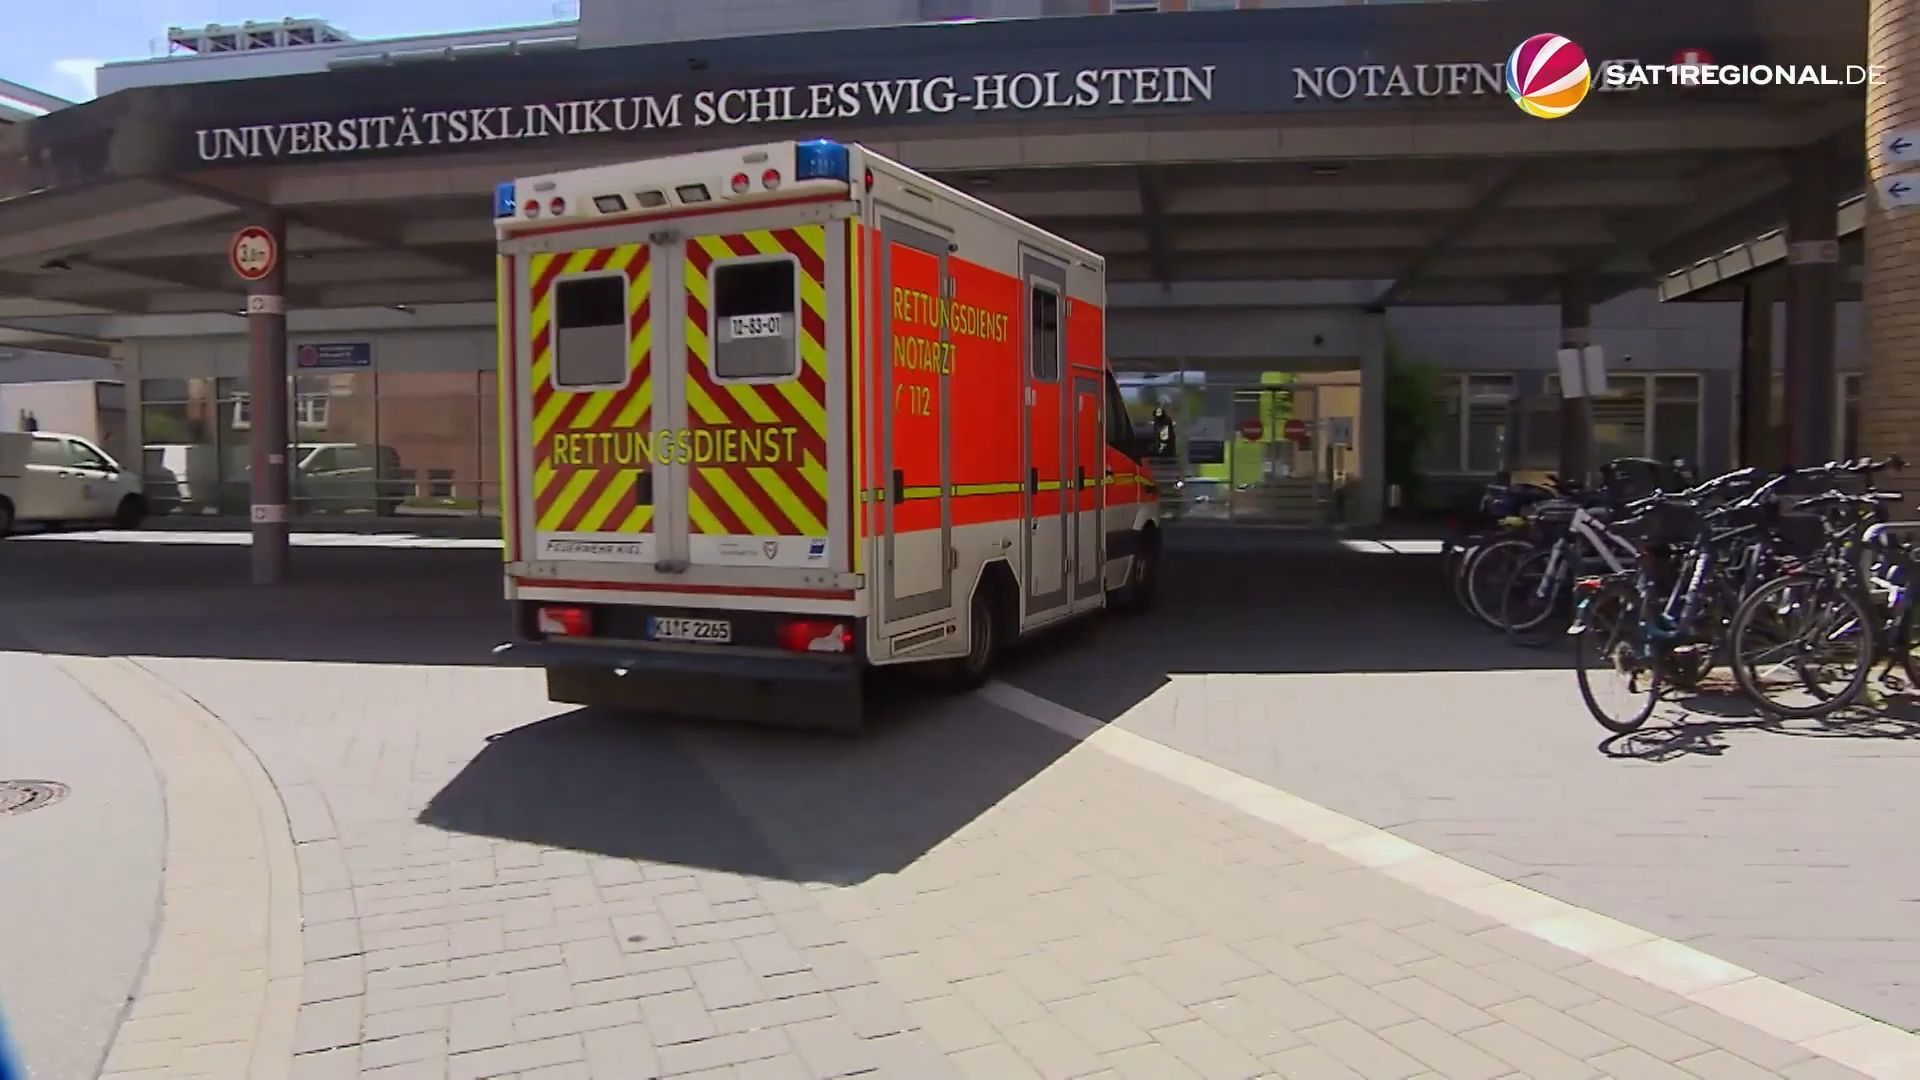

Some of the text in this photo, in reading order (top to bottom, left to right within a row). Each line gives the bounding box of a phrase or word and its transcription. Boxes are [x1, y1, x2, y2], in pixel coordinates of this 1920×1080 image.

[195, 65, 1216, 161] UNIVERSITÄTSKLINIKUM SCHLESWIG-HOLSTEIN
[893, 286, 1009, 343] RETTUNGSDIENST
[893, 335, 957, 376] NOTARZT
[909, 385, 931, 417] 112
[553, 427, 798, 466] RETTUNGSDIENST
